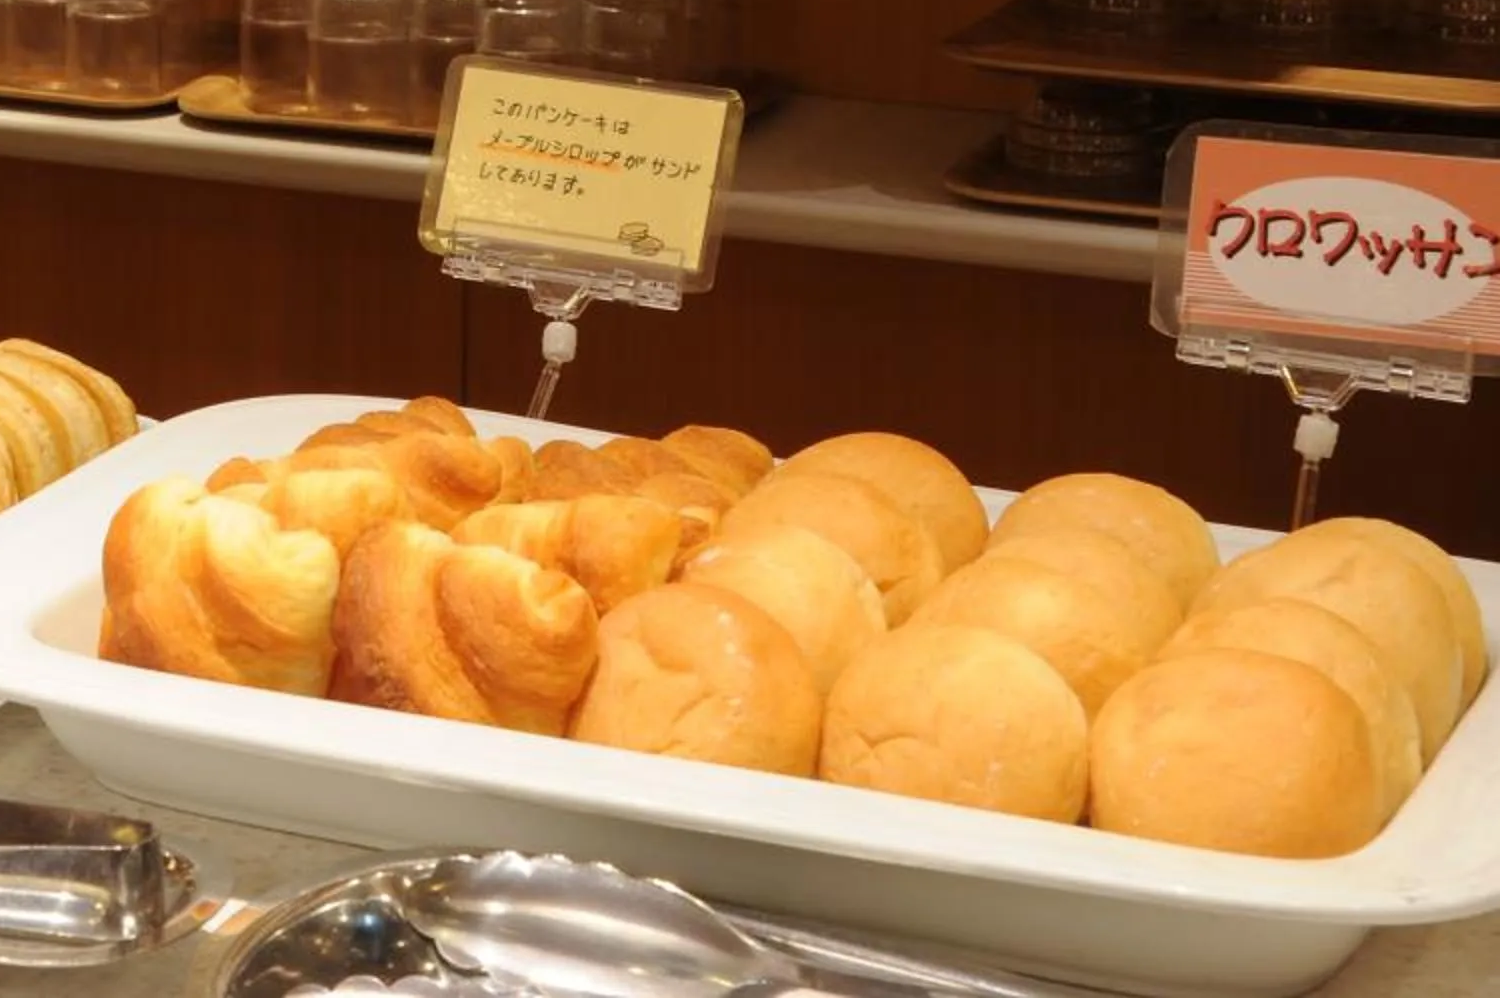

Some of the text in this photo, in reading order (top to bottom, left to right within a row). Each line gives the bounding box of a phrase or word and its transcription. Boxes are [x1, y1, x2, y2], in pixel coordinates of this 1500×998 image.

[492, 97, 631, 136] このパンケーキは
